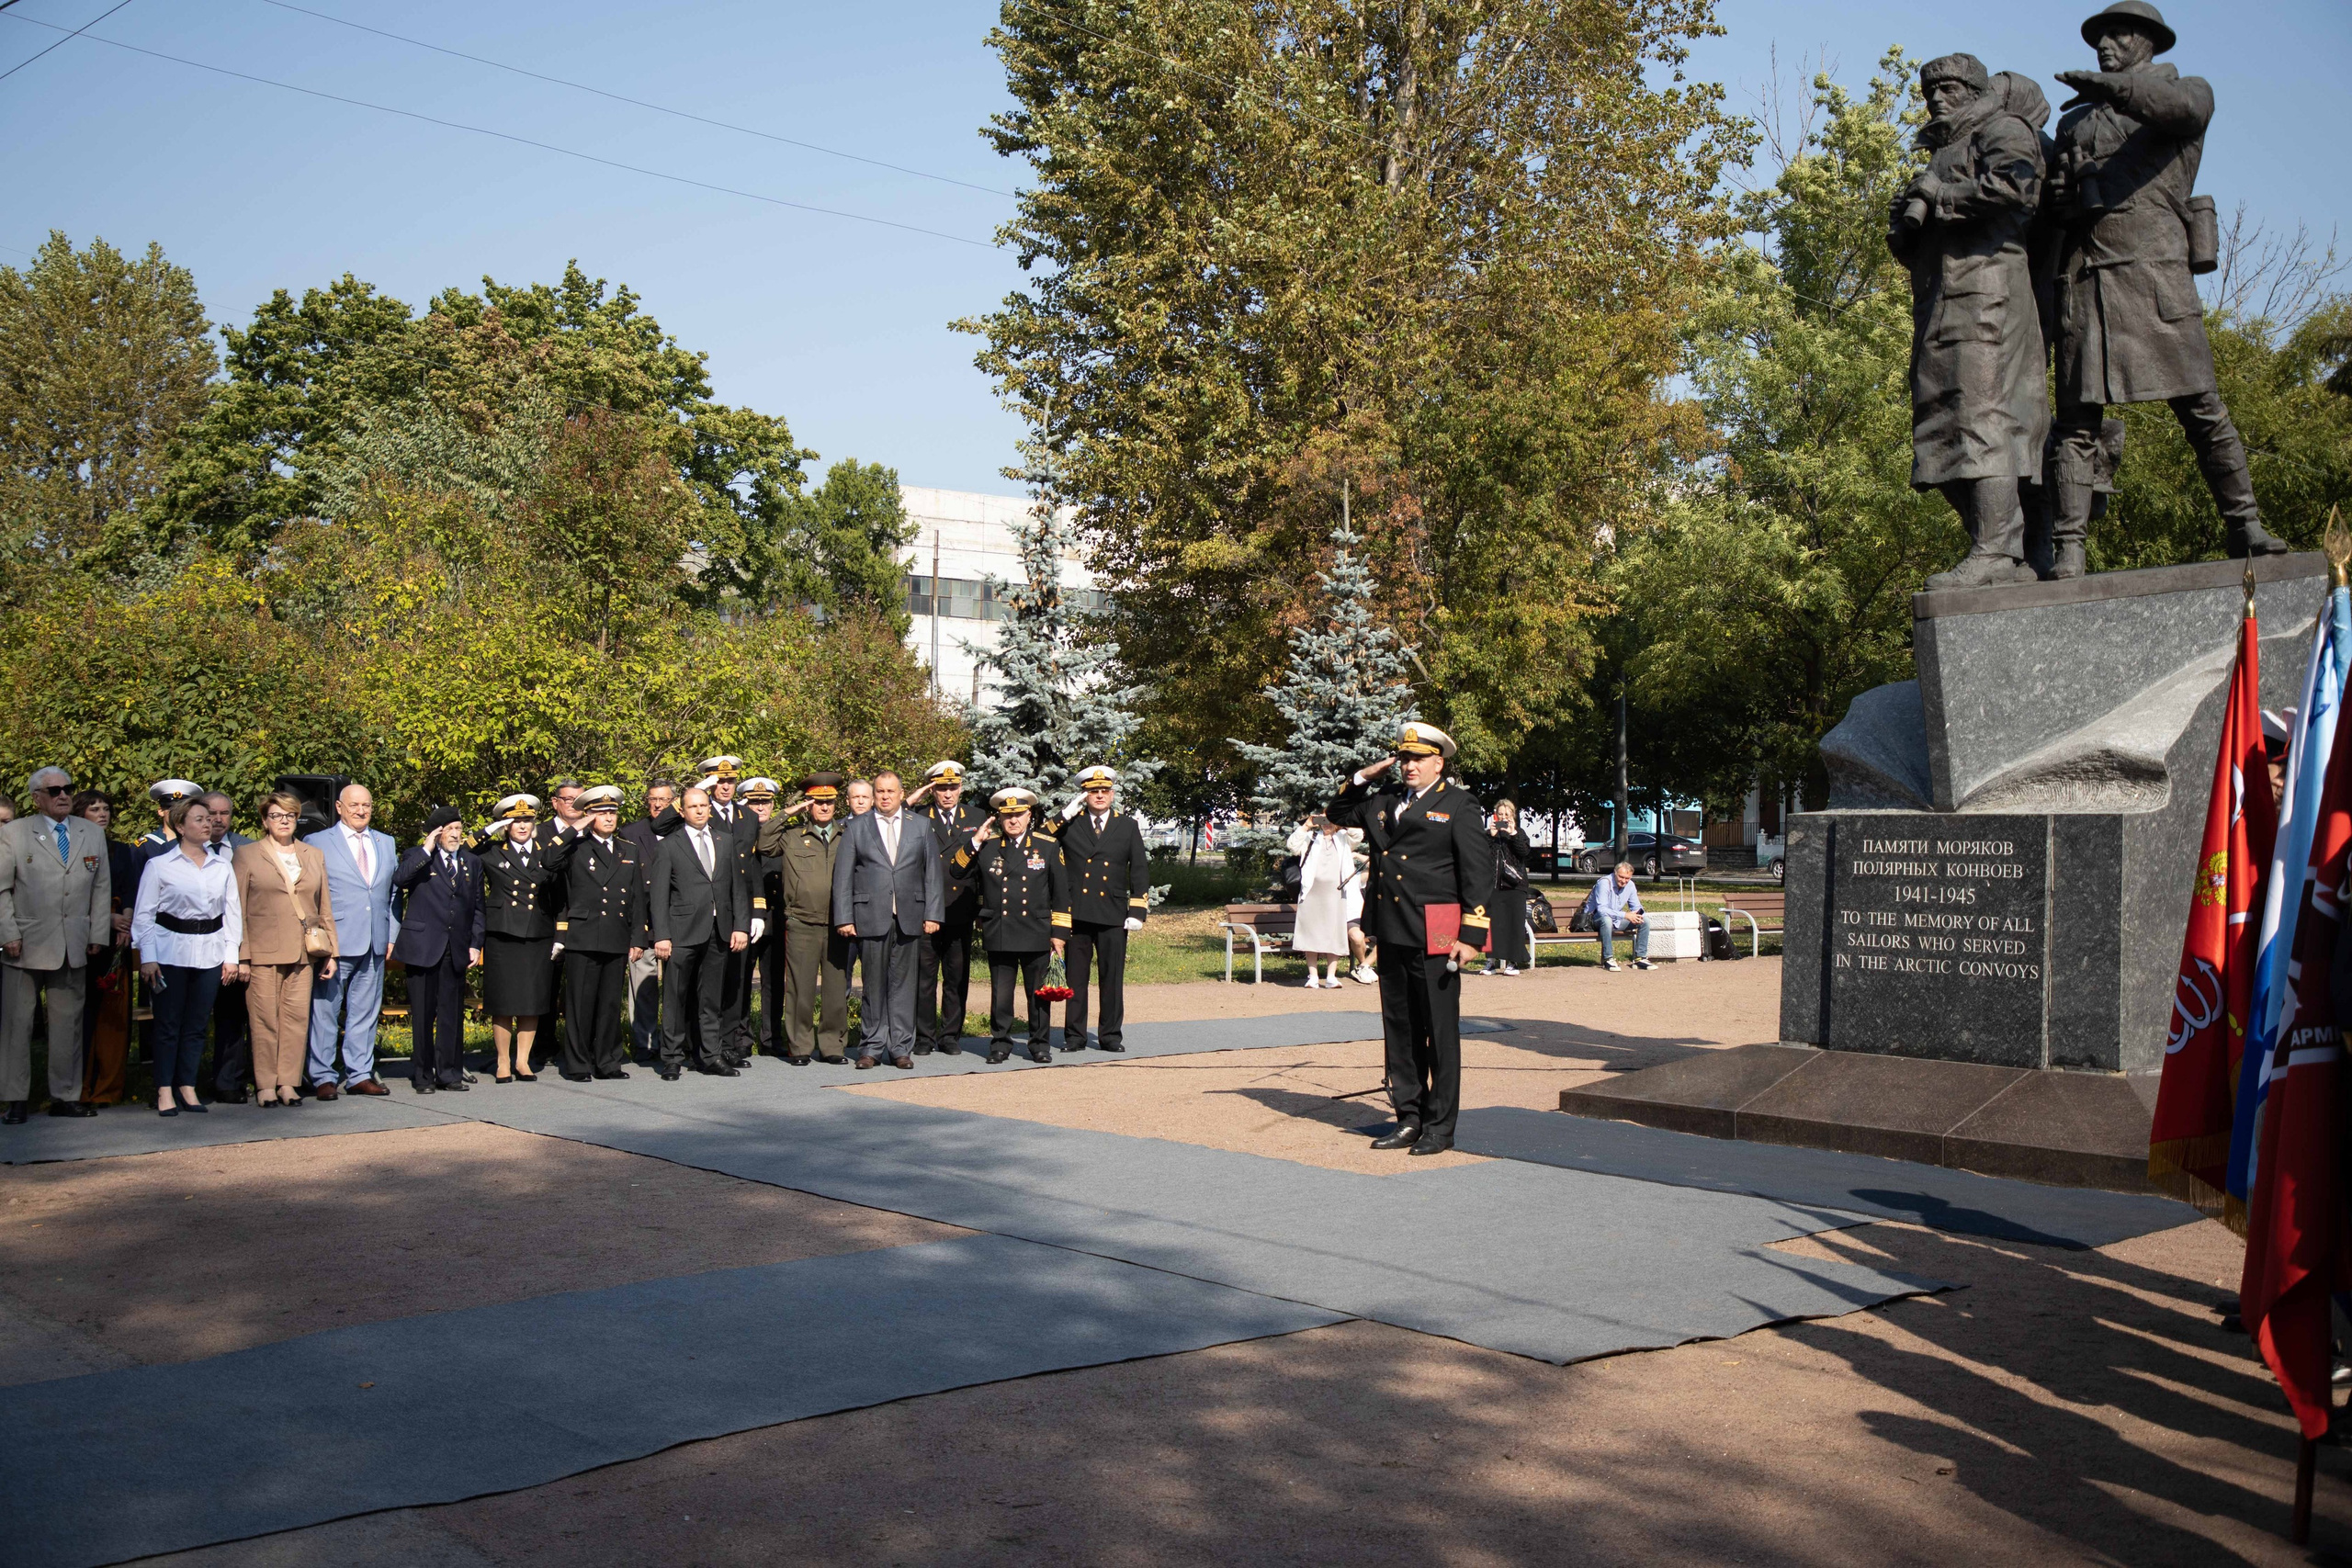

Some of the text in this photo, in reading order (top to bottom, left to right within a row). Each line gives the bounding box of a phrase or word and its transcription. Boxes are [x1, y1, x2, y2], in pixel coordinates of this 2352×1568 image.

[1862, 839, 2014, 856] ПАМЯТИ МОРЯКОВ
[1853, 861, 2024, 879] ПОЛЯРНЫХ КОНВОЕВ
[1894, 886, 1976, 905] 1941-1945
[1840, 910, 2036, 933] TO THE MEMORY OF ALL
[1847, 932, 2026, 956] SAILORS WHO SERVED
[1836, 953, 2040, 980] IN THE ARCTIC CONVOYS
